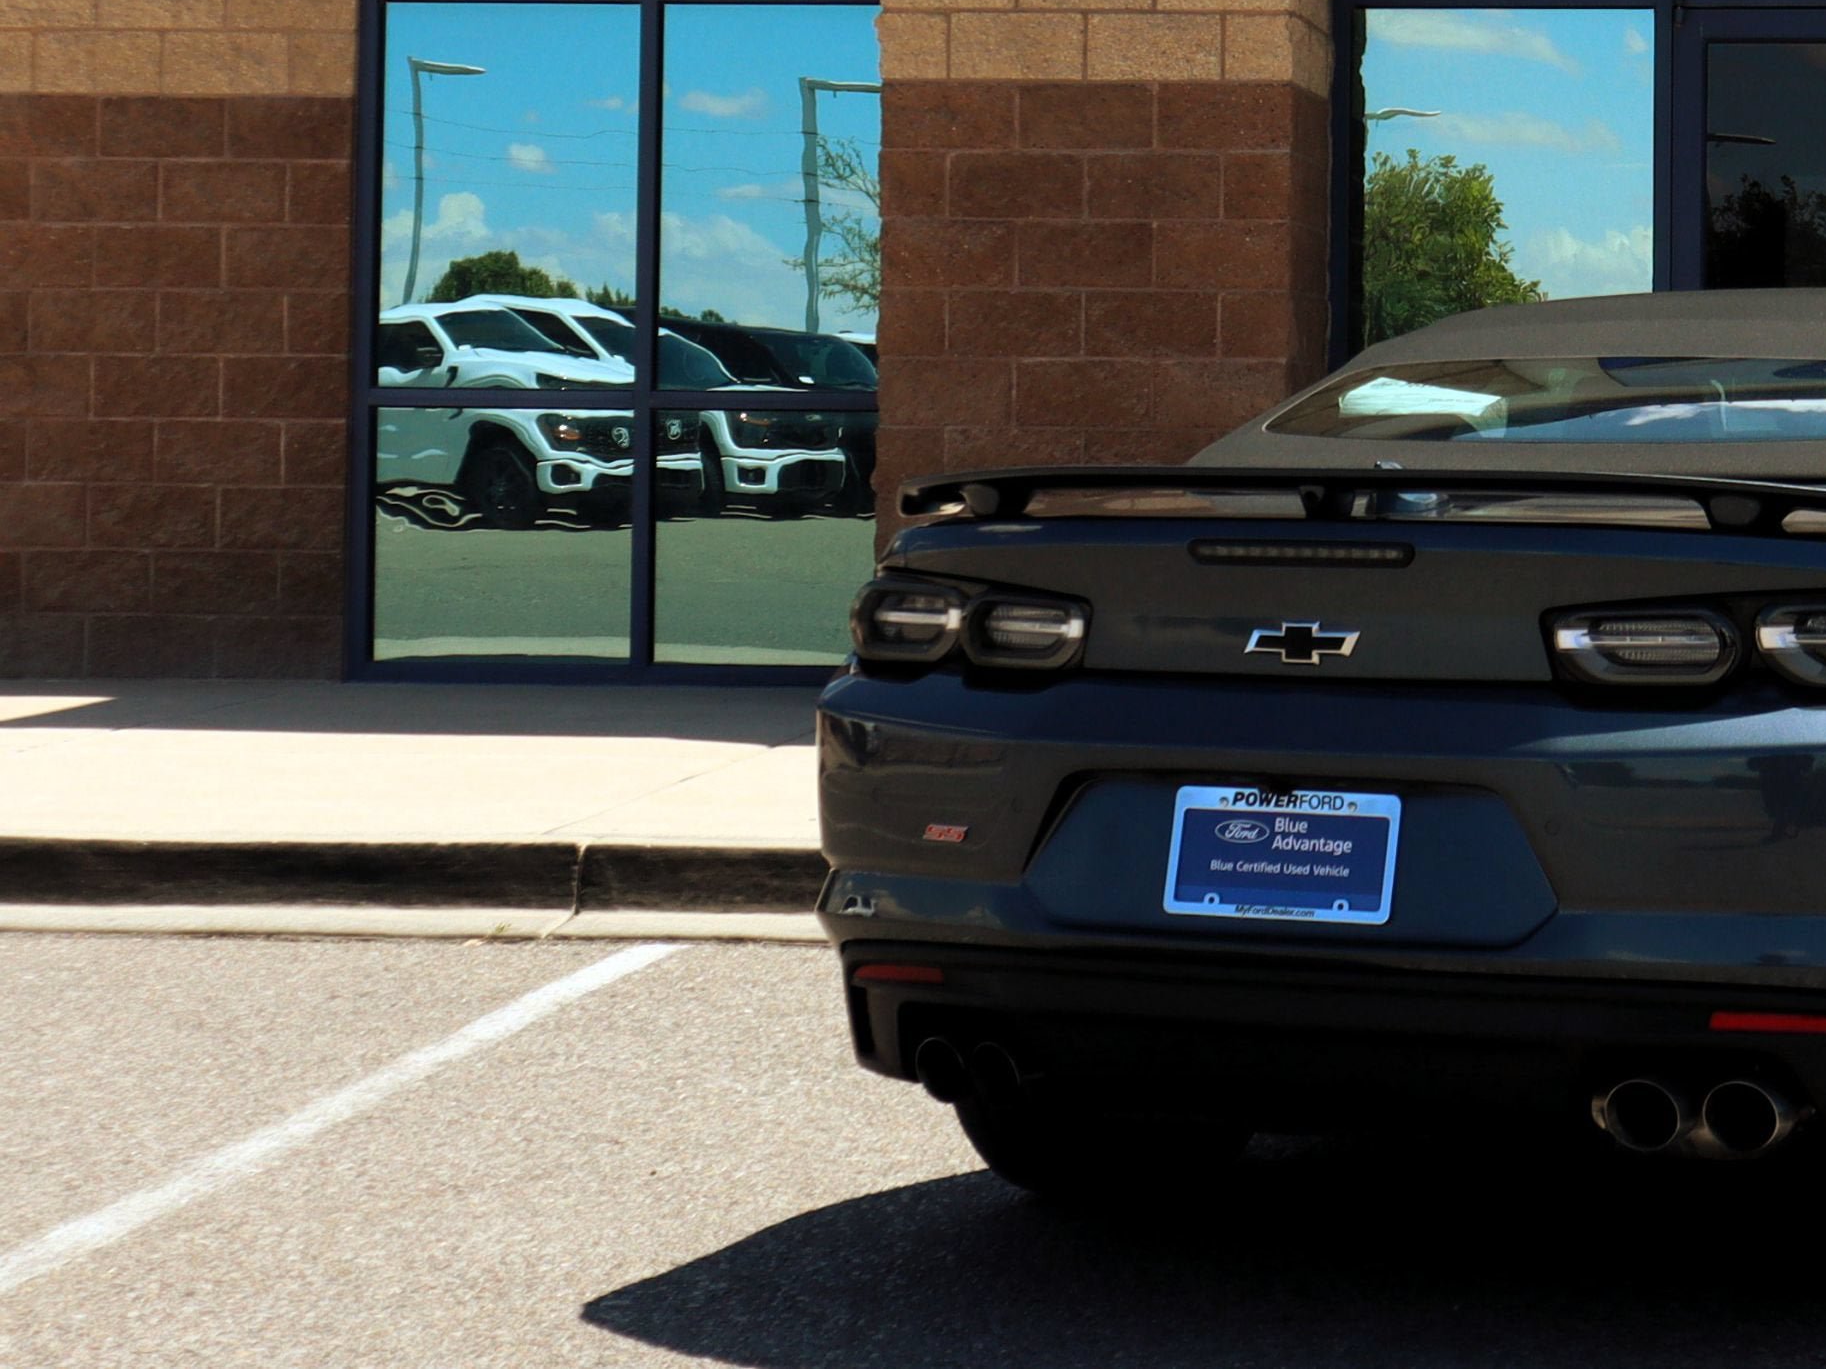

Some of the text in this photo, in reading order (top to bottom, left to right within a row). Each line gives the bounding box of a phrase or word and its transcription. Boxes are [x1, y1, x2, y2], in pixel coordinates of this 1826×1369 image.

[1224, 823, 1259, 840] Ford
[1275, 817, 1308, 834] Blue
[1272, 835, 1352, 856] Advantage
[1210, 859, 1350, 877] Blue Certified Used Vehicle
